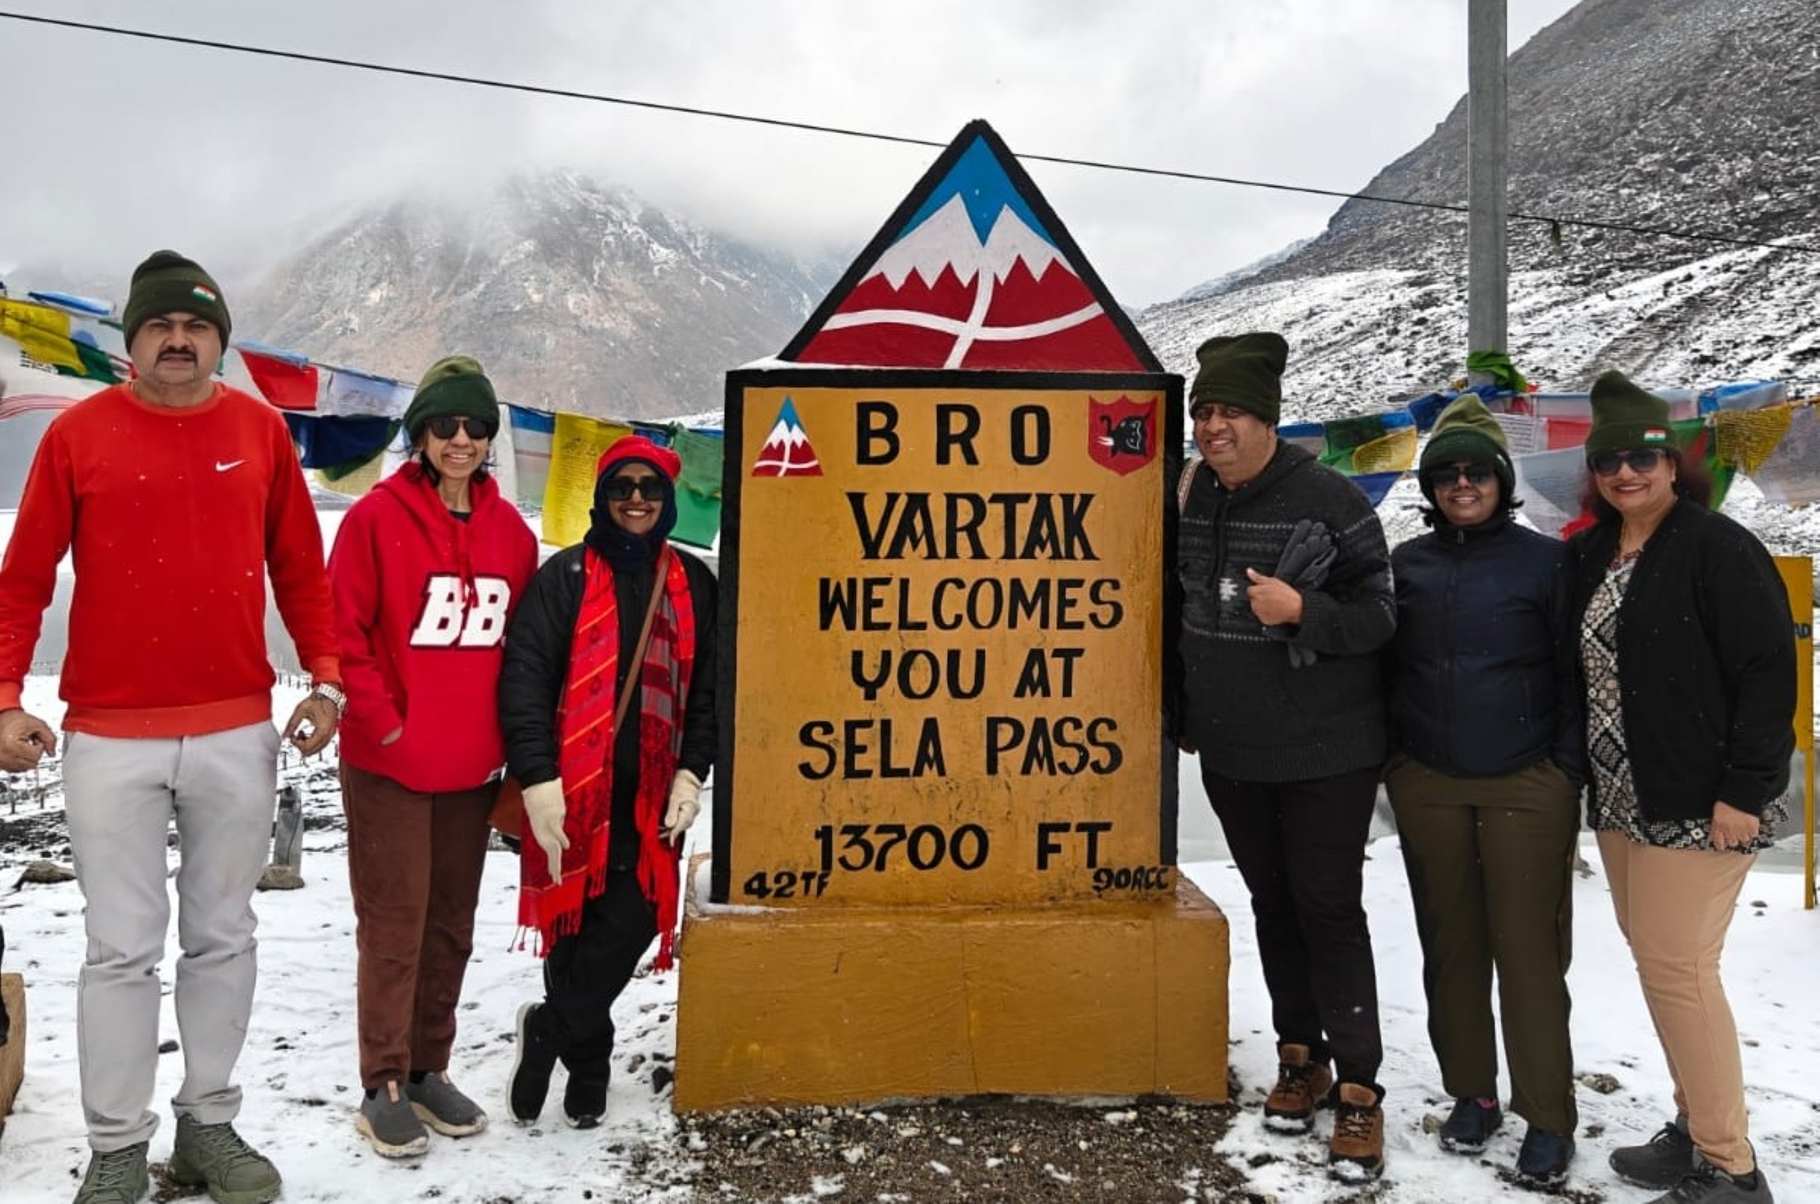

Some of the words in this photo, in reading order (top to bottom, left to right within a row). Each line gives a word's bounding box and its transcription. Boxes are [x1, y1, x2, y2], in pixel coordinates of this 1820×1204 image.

[846, 491, 1100, 561] VARTAK
[819, 577, 1124, 632] WELCOMES
[851, 648, 986, 701] YOU
[1013, 647, 1085, 698] AT
[798, 717, 946, 781] SELA
[986, 716, 1123, 777] PASS
[814, 823, 990, 872] 13700
[1036, 821, 1113, 871] FT
